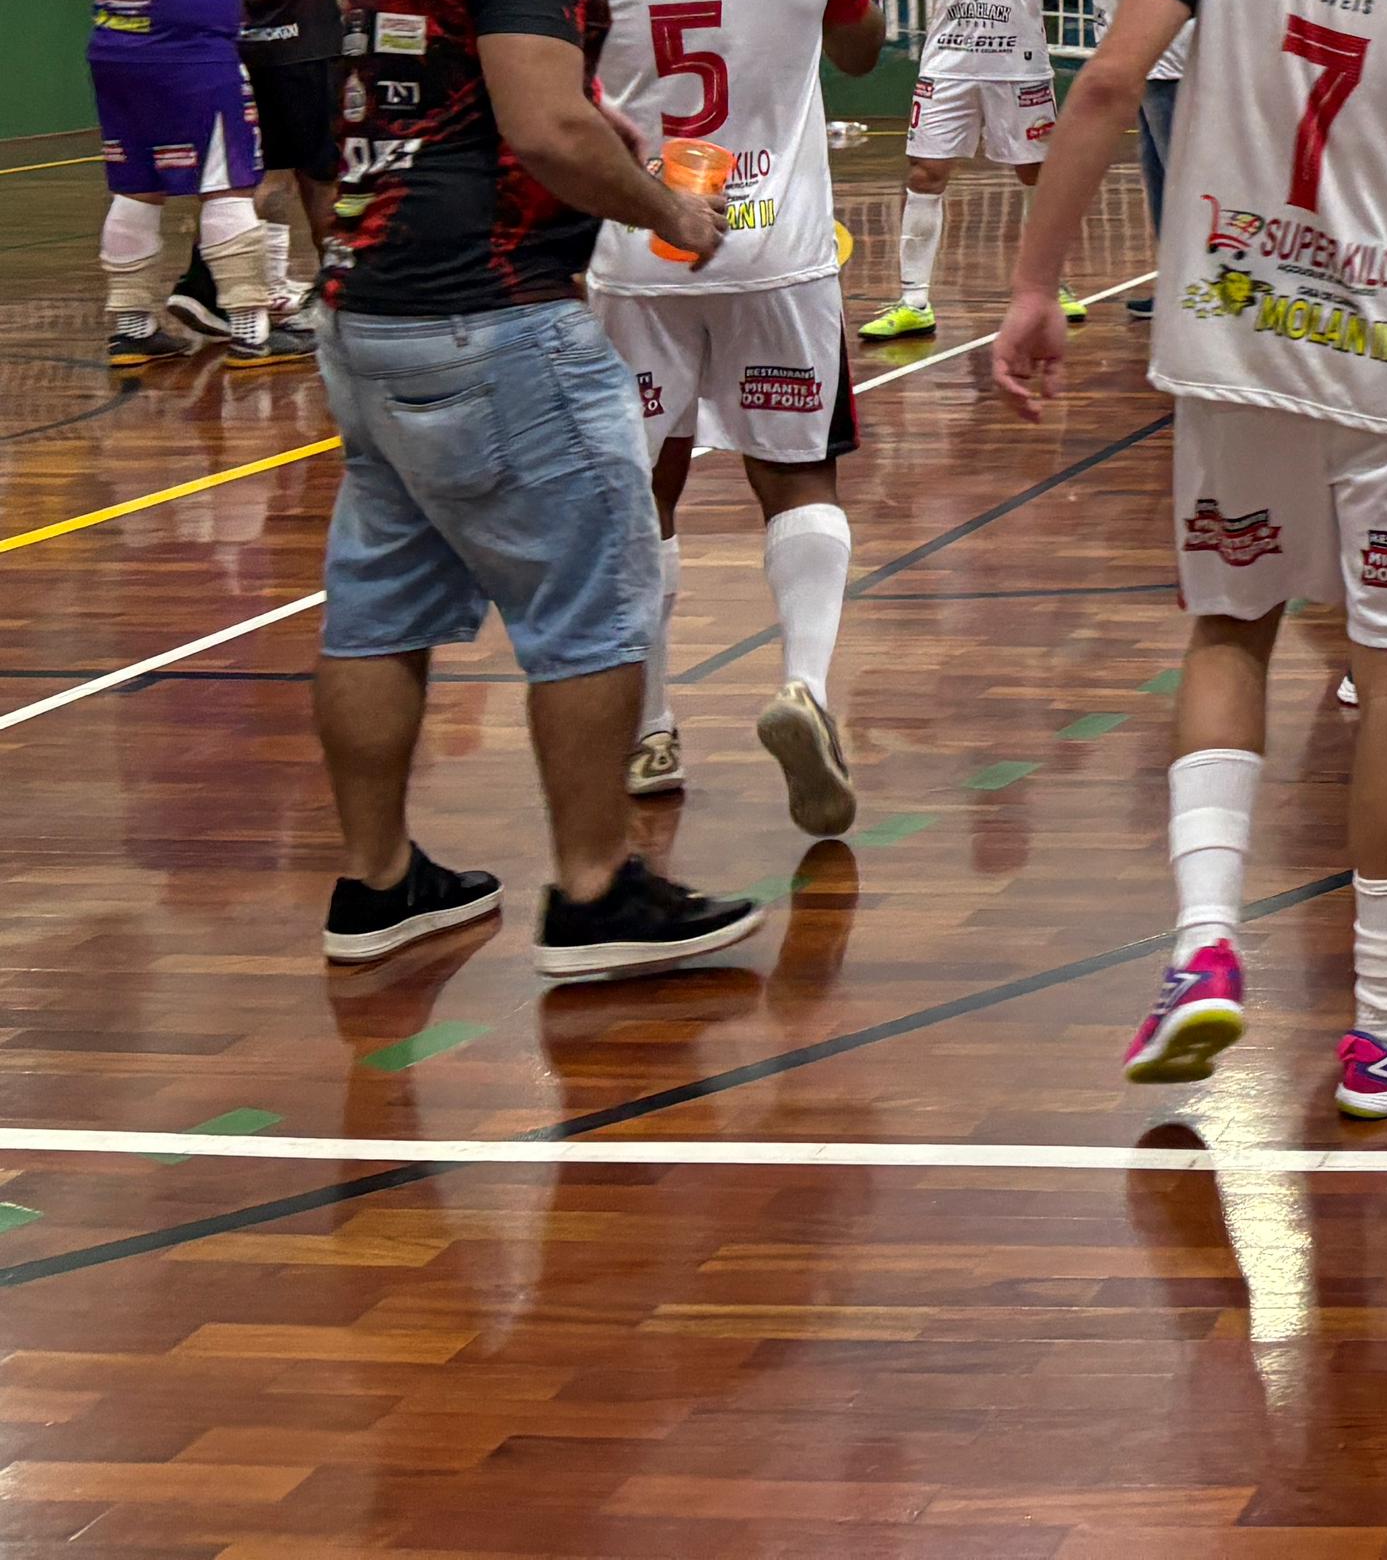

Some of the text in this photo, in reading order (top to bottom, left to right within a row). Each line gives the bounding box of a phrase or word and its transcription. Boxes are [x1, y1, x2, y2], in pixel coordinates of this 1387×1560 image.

[648, 0, 729, 138] 5
[1283, 13, 1371, 214] 7
[731, 149, 771, 182] KILO
[1260, 218, 1339, 269] SUPER
[1255, 293, 1369, 357] MOLAN
[742, 394, 765, 406] DO
